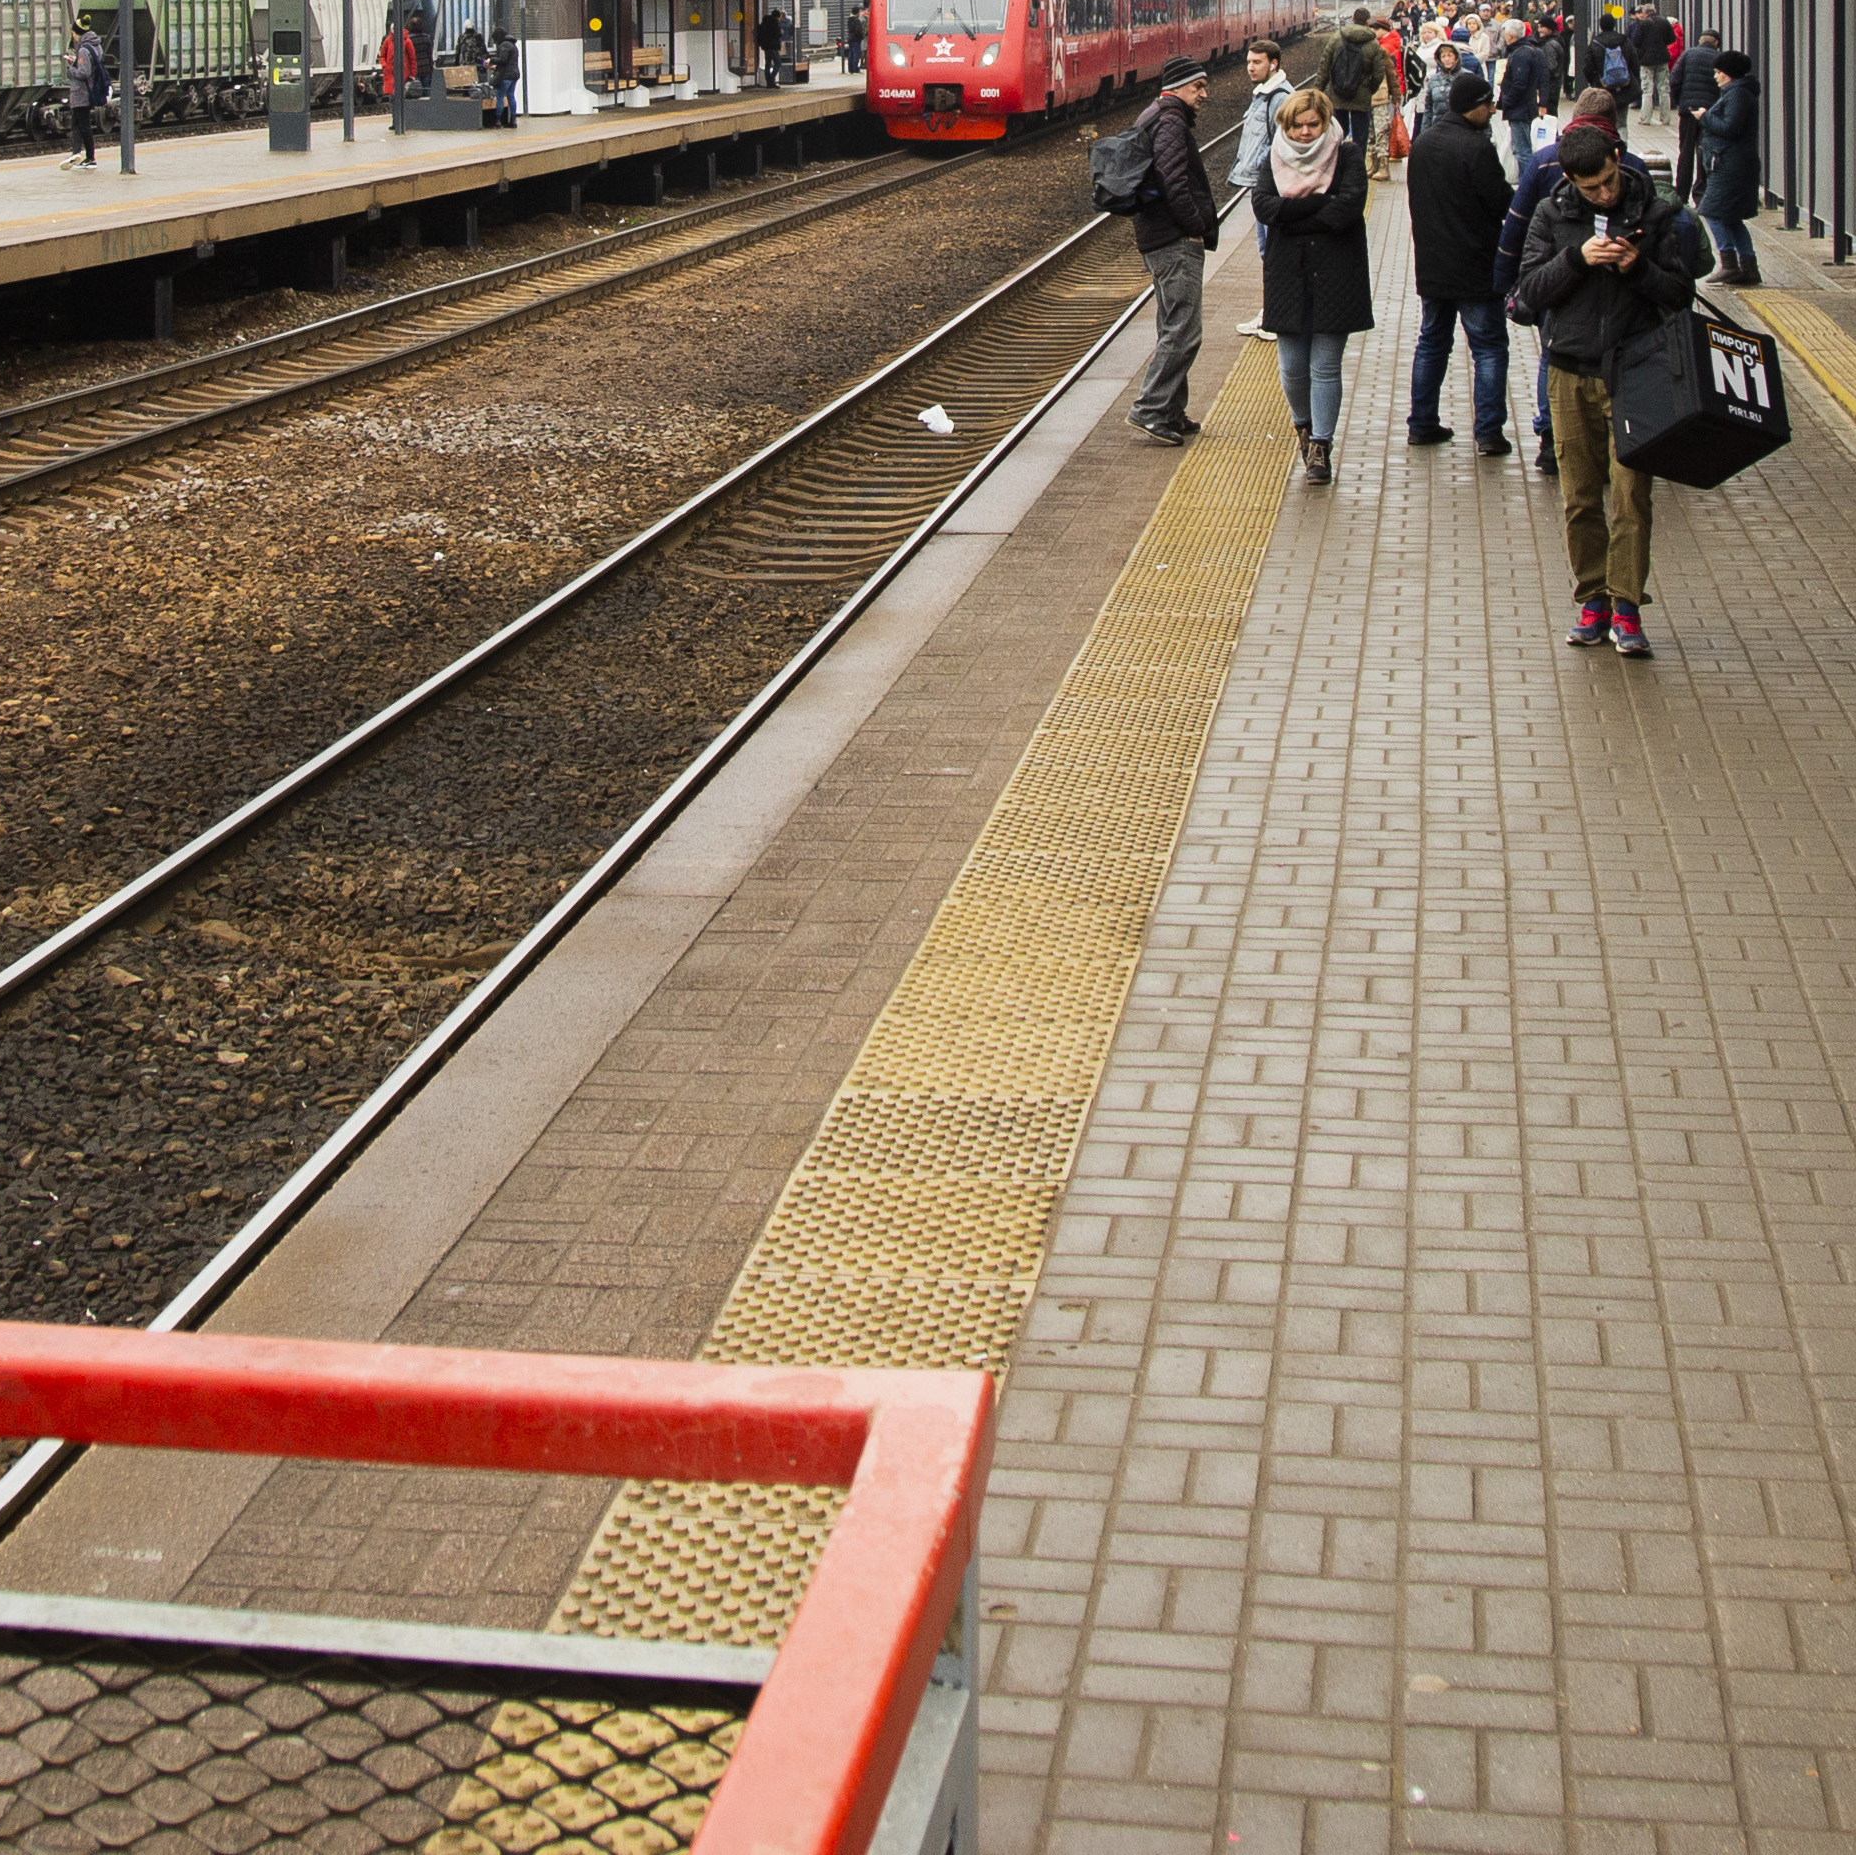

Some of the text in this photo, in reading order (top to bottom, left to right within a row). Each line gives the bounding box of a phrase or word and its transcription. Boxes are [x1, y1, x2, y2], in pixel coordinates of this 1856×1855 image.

[980, 88, 1000, 98] 0001
[1711, 330, 1759, 356] ПИРОГИ
[1728, 404, 1763, 423] PIR1.RU
